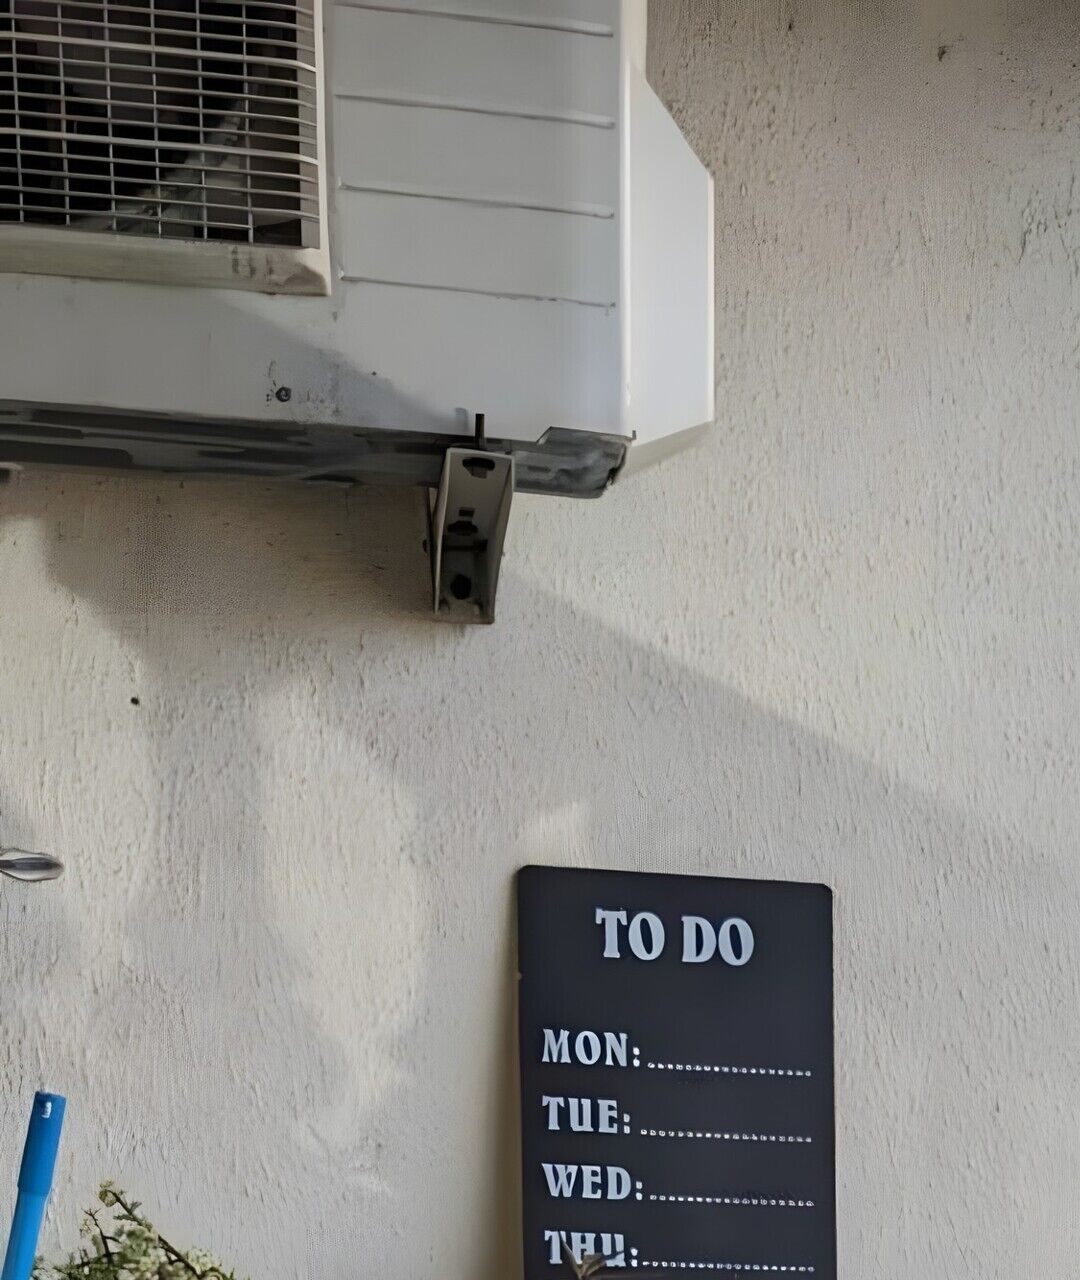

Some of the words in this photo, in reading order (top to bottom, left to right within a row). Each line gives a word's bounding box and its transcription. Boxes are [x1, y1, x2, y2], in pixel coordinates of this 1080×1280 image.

[595, 907, 665, 961] TO
[681, 915, 755, 967] DO
[541, 1028, 641, 1068] MON:
[541, 1095, 631, 1134] TUE:
[541, 1163, 643, 1201] WED:
